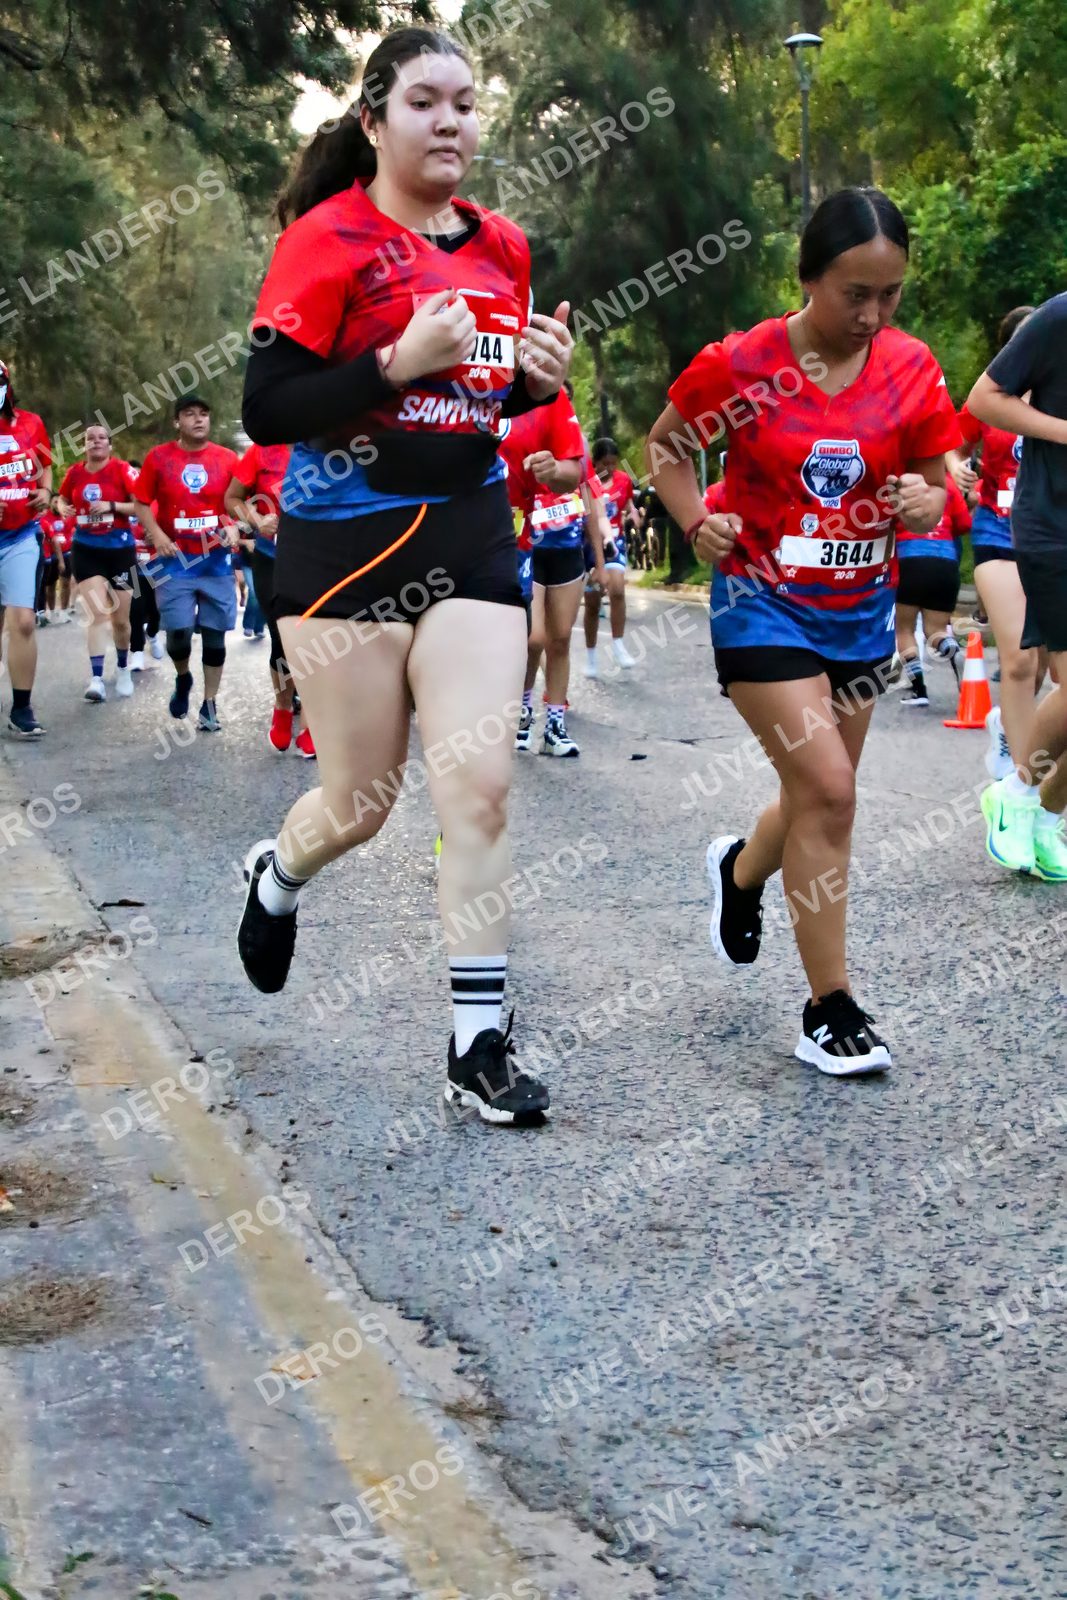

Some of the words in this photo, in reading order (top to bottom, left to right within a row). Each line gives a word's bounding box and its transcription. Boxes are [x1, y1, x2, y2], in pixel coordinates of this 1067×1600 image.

[818, 446, 853, 455] BIMBO
[818, 458, 851, 470] Global
[810, 468, 837, 476] Race
[546, 504, 569, 519] 3626
[188, 517, 206, 527] 2774
[820, 541, 874, 567] 3644
